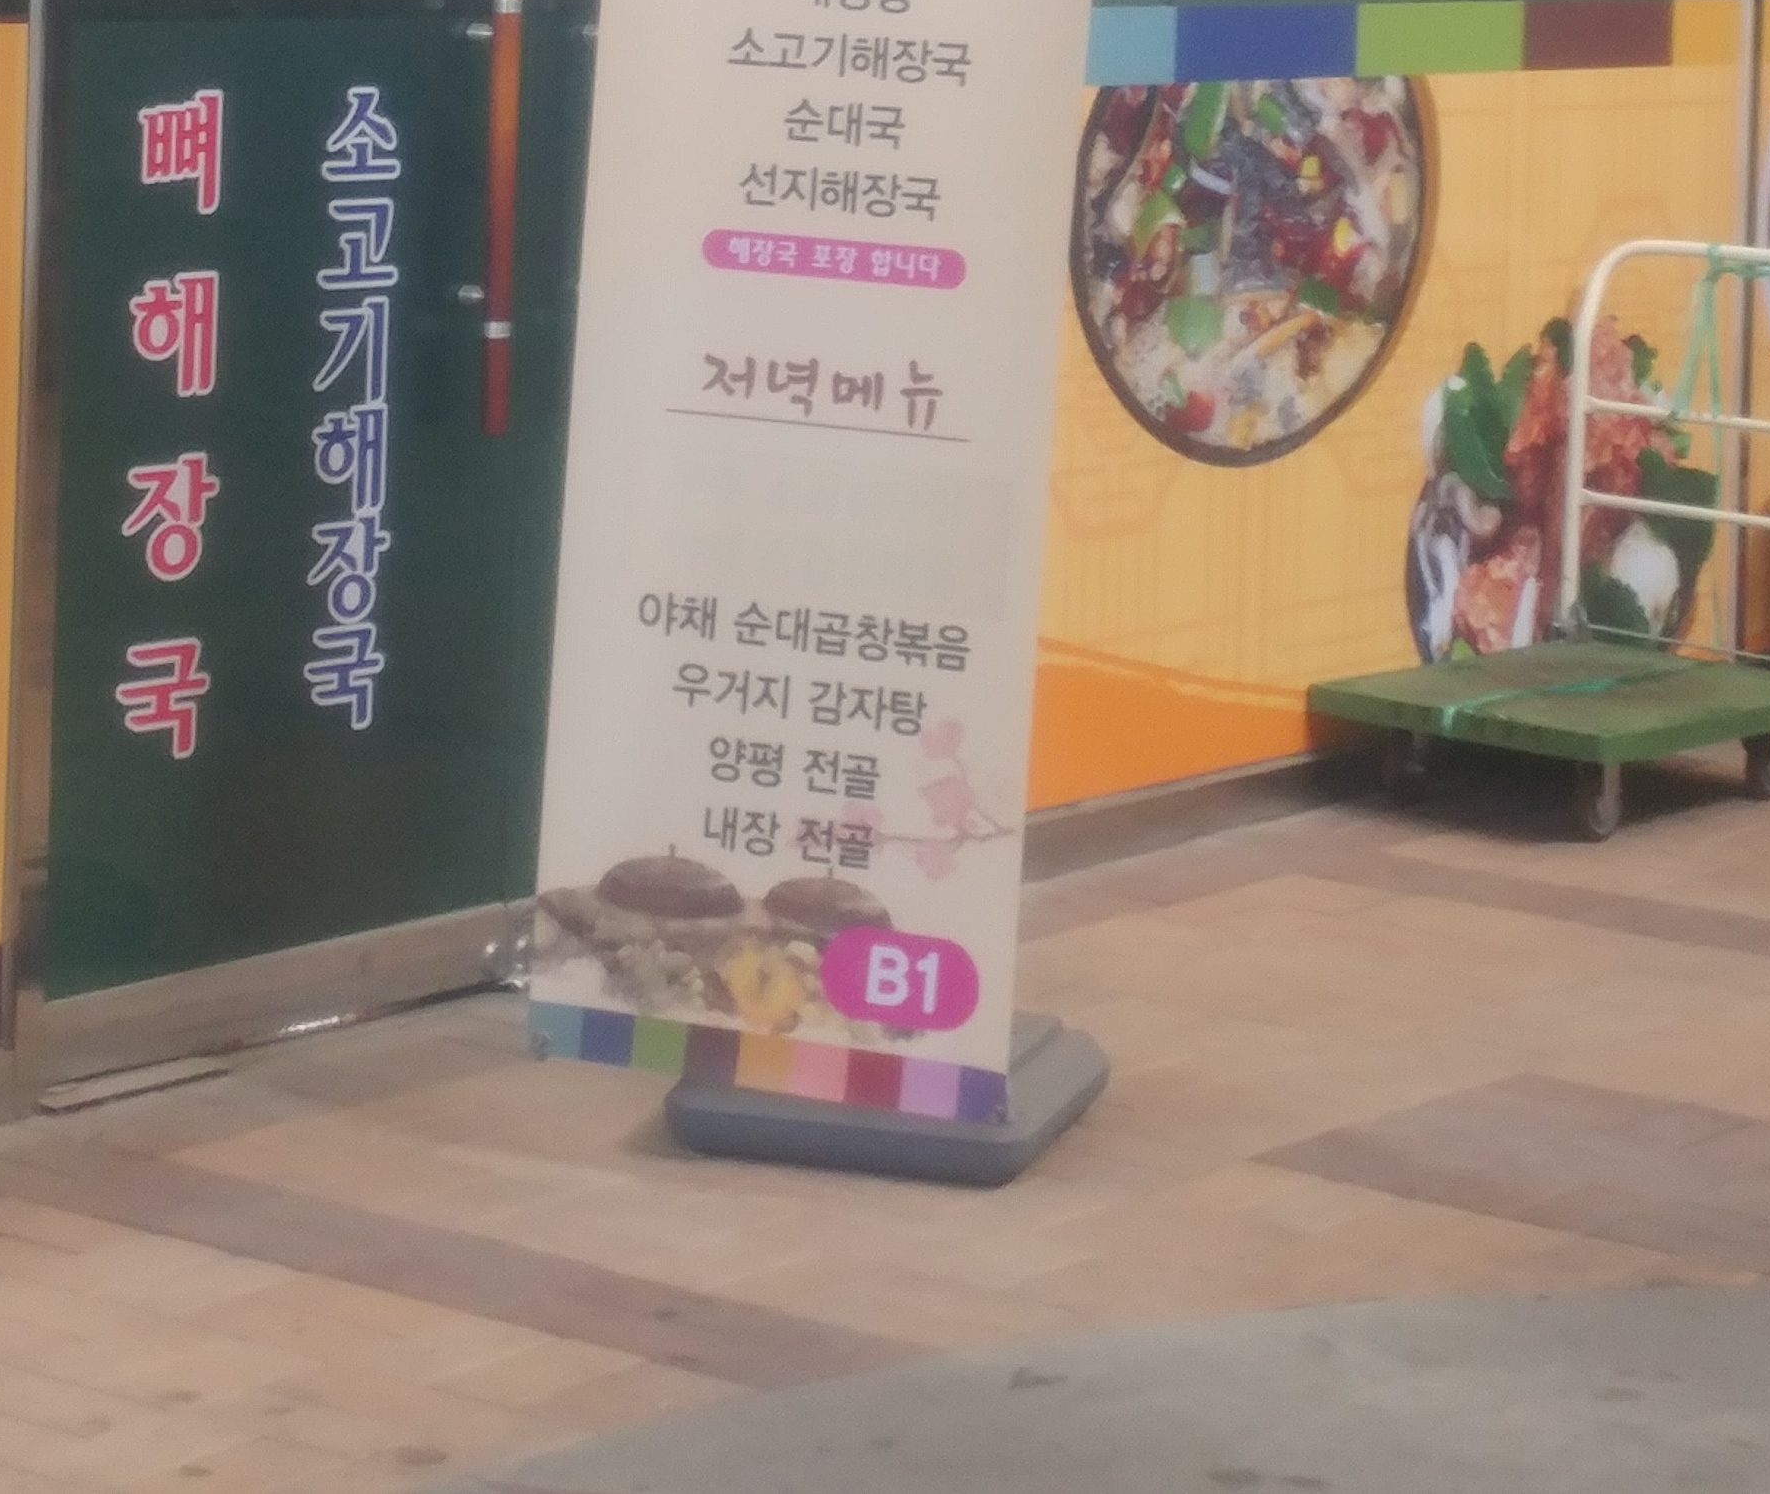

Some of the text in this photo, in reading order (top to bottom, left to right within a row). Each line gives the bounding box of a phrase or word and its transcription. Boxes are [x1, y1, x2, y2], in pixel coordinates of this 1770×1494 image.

[726, 27, 973, 87] 소고기해장국
[783, 98, 907, 150] 순대국
[738, 162, 942, 222] 선지해장국
[728, 236, 942, 282] 해장국 포장 합니다
[116, 89, 224, 760] 뼈해장국
[304, 86, 402, 731] 소고기해장국
[700, 352, 945, 432] 저녁메뉴
[637, 590, 972, 673] 야채 순대곱창볶음
[671, 662, 928, 738] 우거지 감자탕
[708, 736, 882, 802] 양평 전골
[703, 805, 875, 871] 내장 전골
[863, 944, 941, 1015] B1
